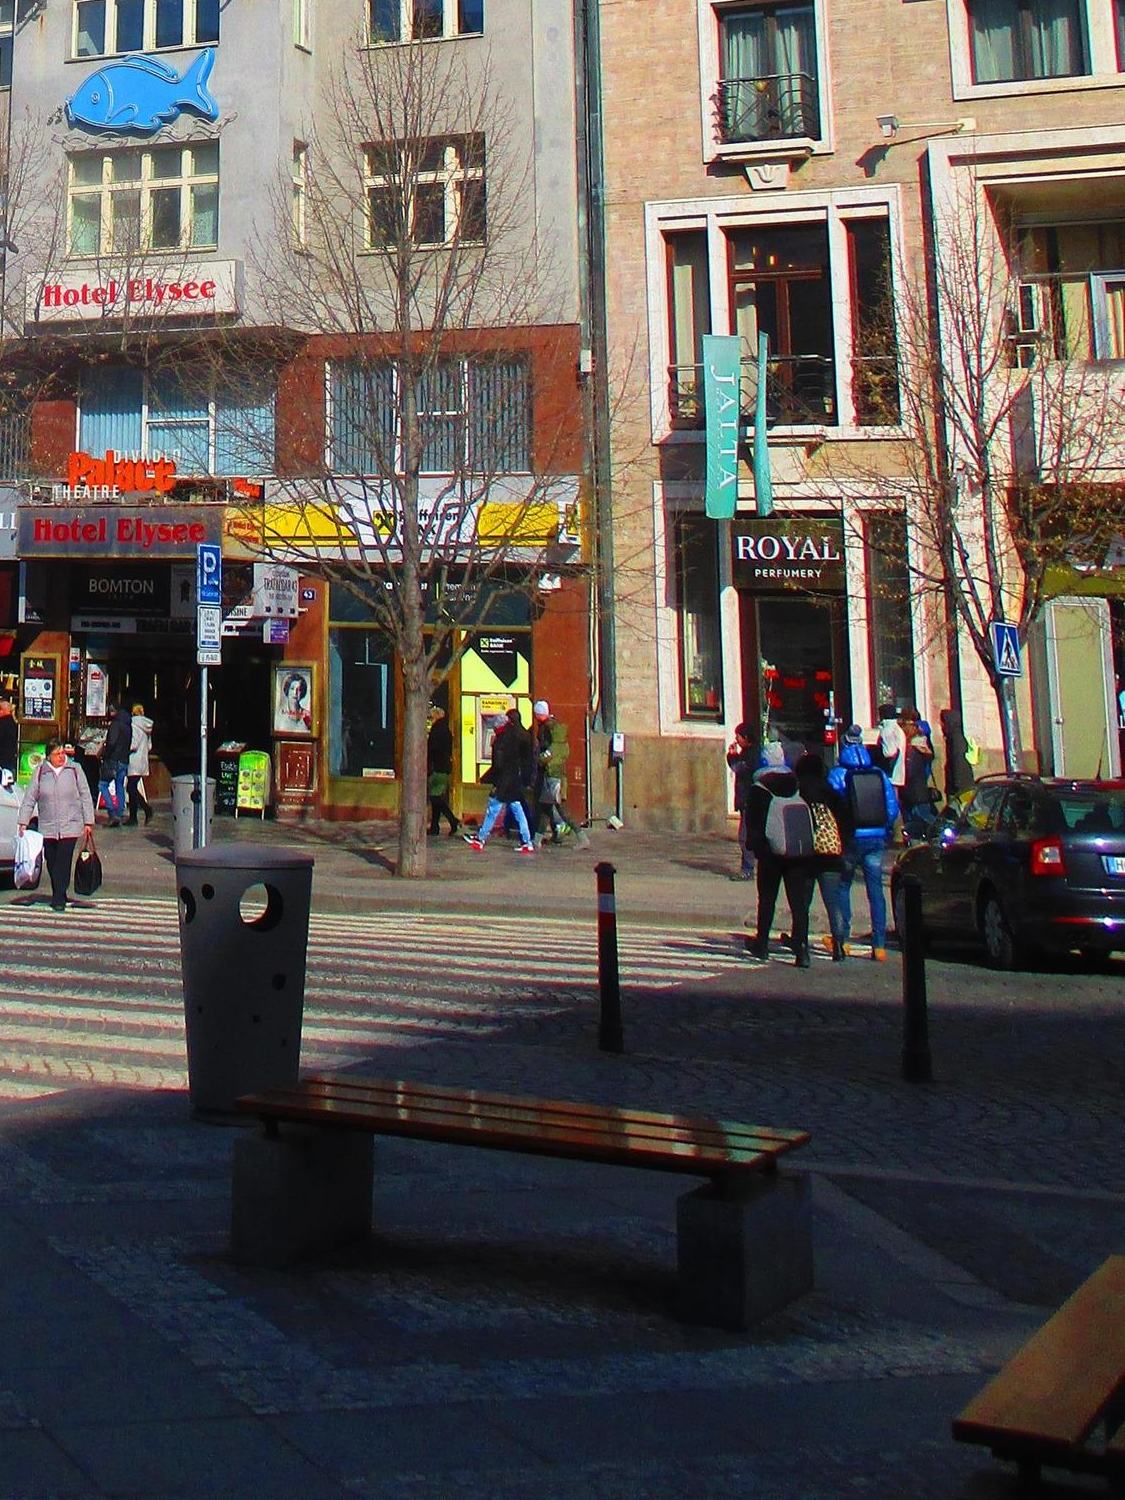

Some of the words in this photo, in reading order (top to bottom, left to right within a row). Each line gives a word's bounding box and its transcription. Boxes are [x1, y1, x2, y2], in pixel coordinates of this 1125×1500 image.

[44, 280, 116, 307] Hotel
[128, 279, 216, 307] Elysee
[711, 365, 738, 489] JALTA
[113, 449, 182, 464] DIVADLO
[52, 484, 120, 500] THEATRE
[33, 517, 106, 543] Hotel
[116, 518, 207, 549] Elysee
[736, 535, 840, 560] ROYAL
[203, 551, 216, 585] P
[755, 568, 822, 578] PERFUMERY
[89, 579, 155, 594] BOMTON
